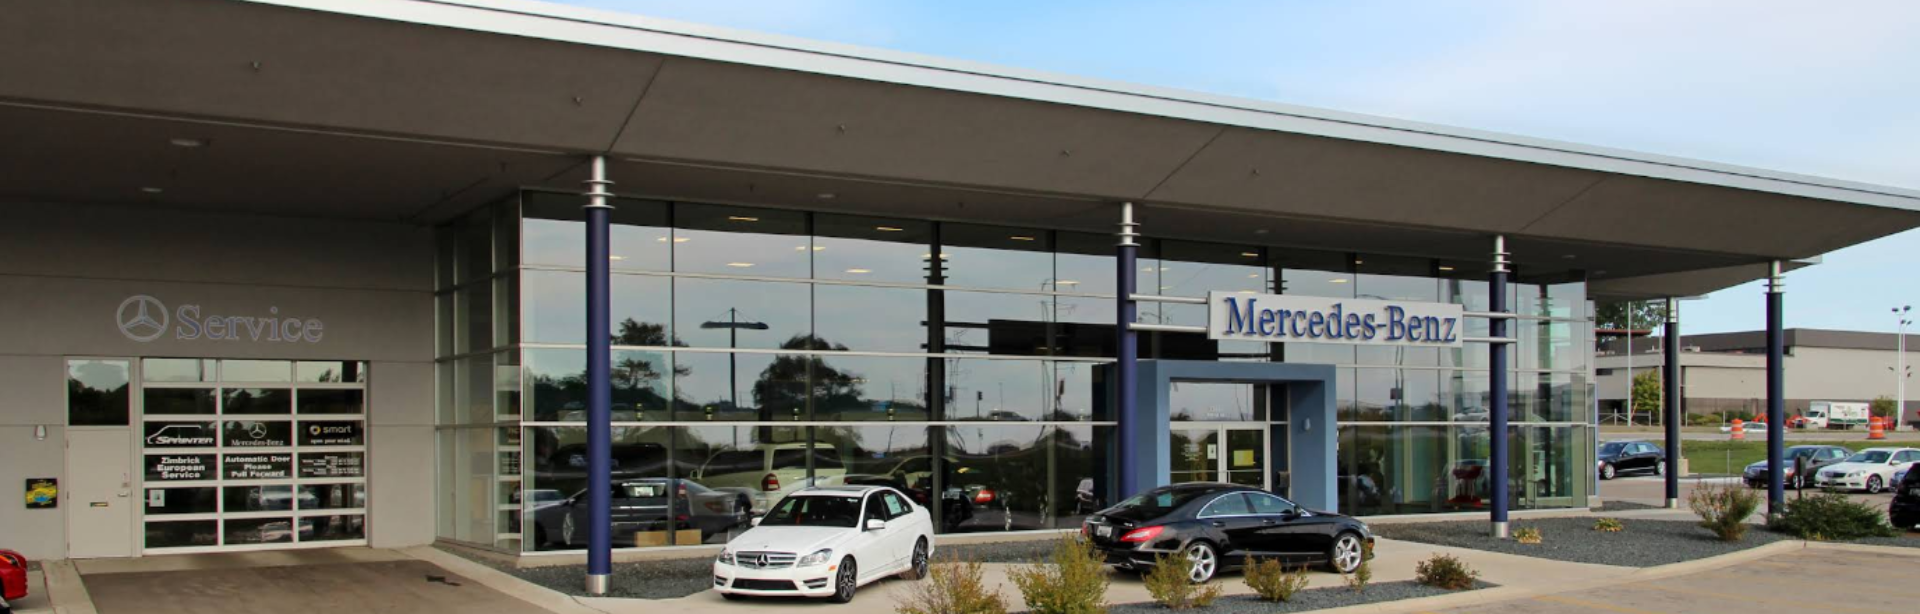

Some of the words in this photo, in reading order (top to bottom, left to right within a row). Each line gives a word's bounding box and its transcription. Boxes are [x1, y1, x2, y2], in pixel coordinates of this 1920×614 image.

[1223, 296, 1457, 342] Mercedes-Benz
[176, 304, 323, 343] Service
[323, 425, 352, 434] smart
[161, 456, 201, 464] Zimbrick
[156, 464, 206, 472] European
[161, 471, 201, 479] Service
[231, 470, 248, 478] Pull
